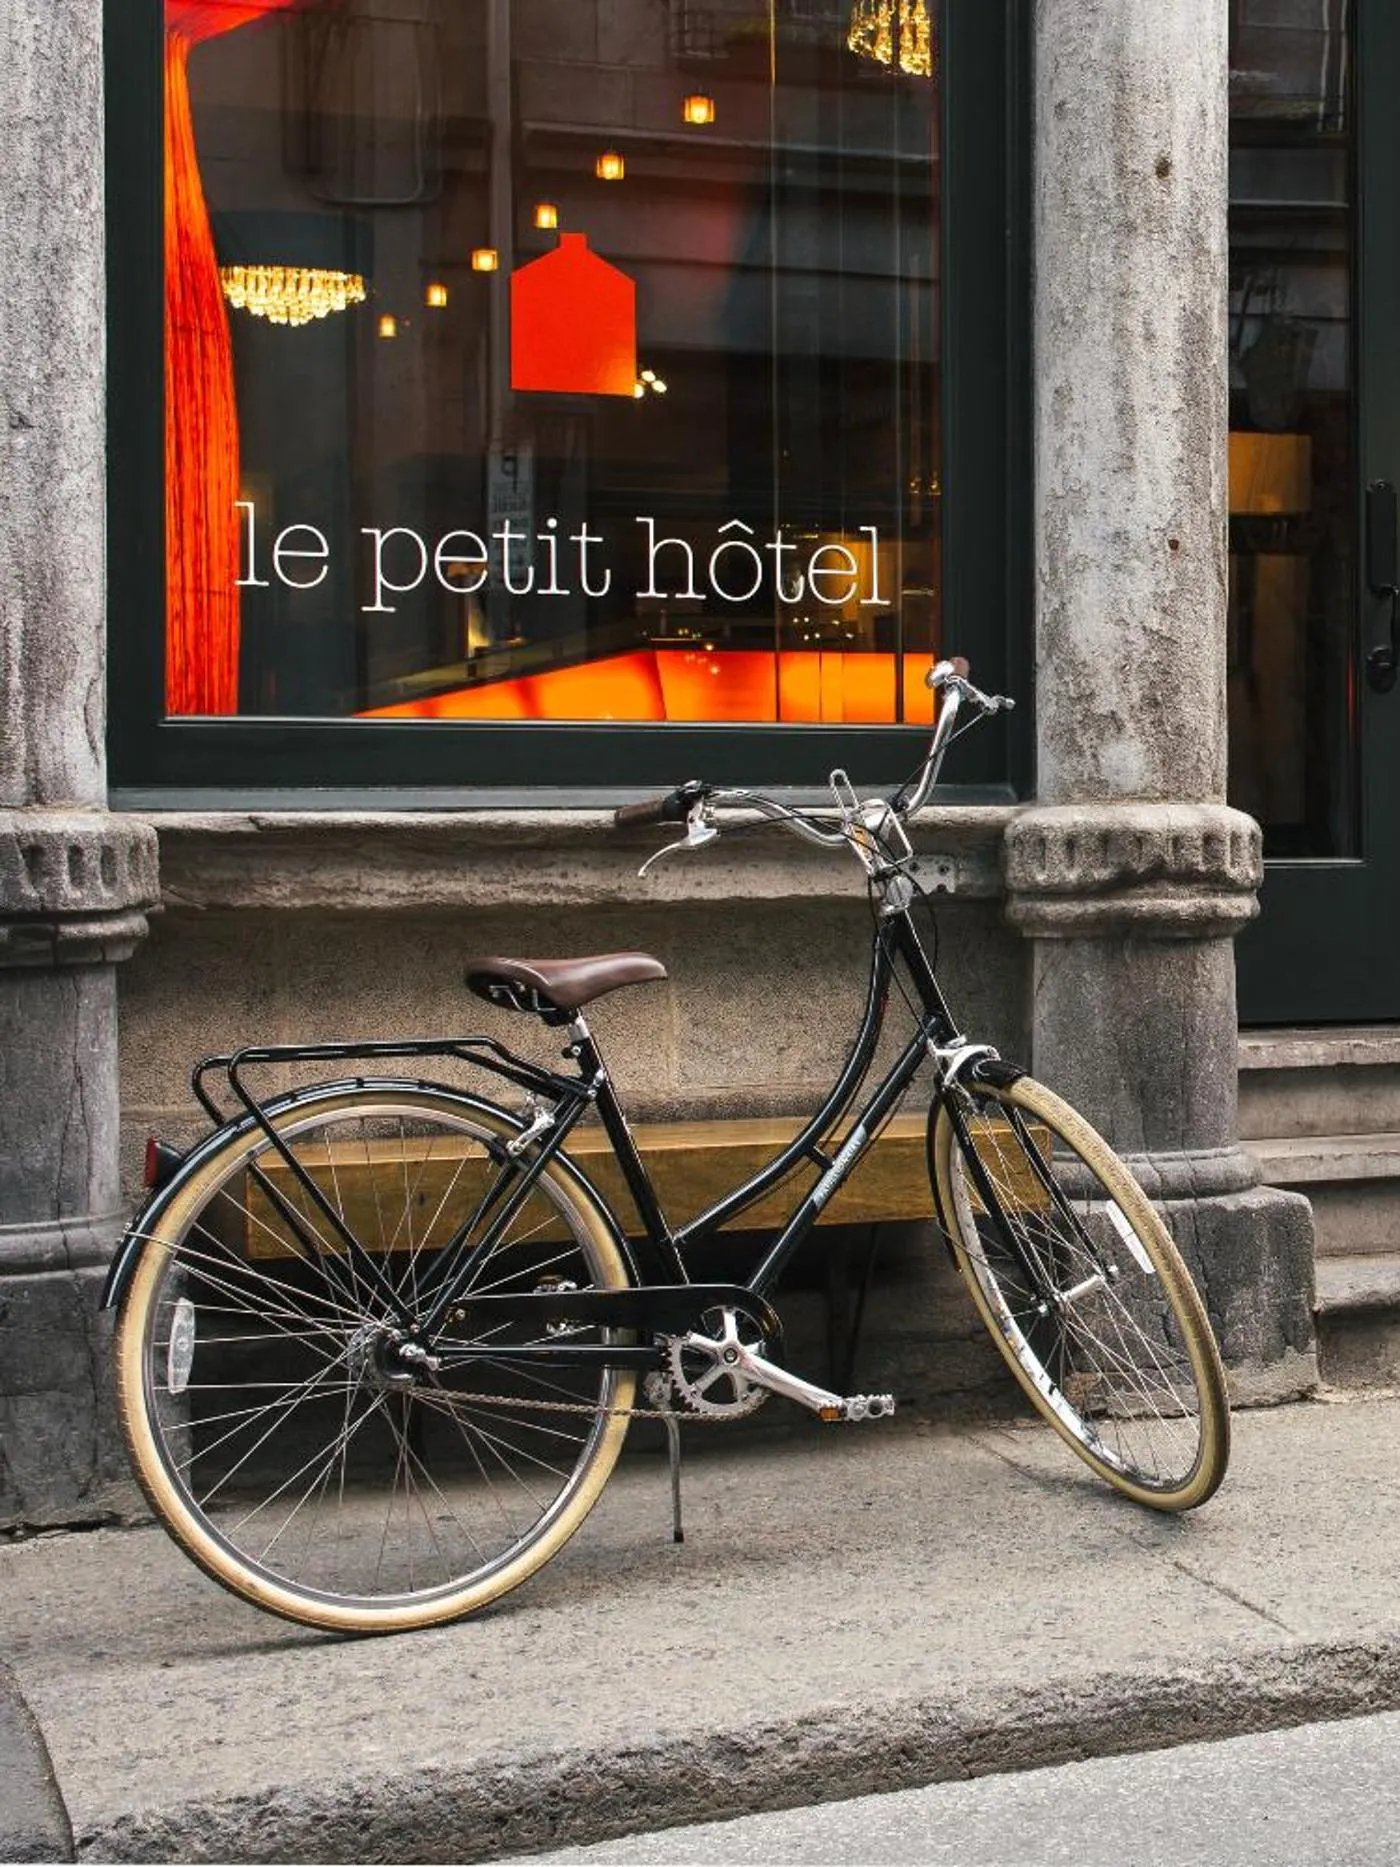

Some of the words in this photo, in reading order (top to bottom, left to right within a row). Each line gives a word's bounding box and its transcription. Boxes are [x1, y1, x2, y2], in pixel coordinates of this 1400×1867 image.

[234, 501, 330, 589] le
[361, 517, 612, 613] petit
[635, 516, 892, 605] hôtel
